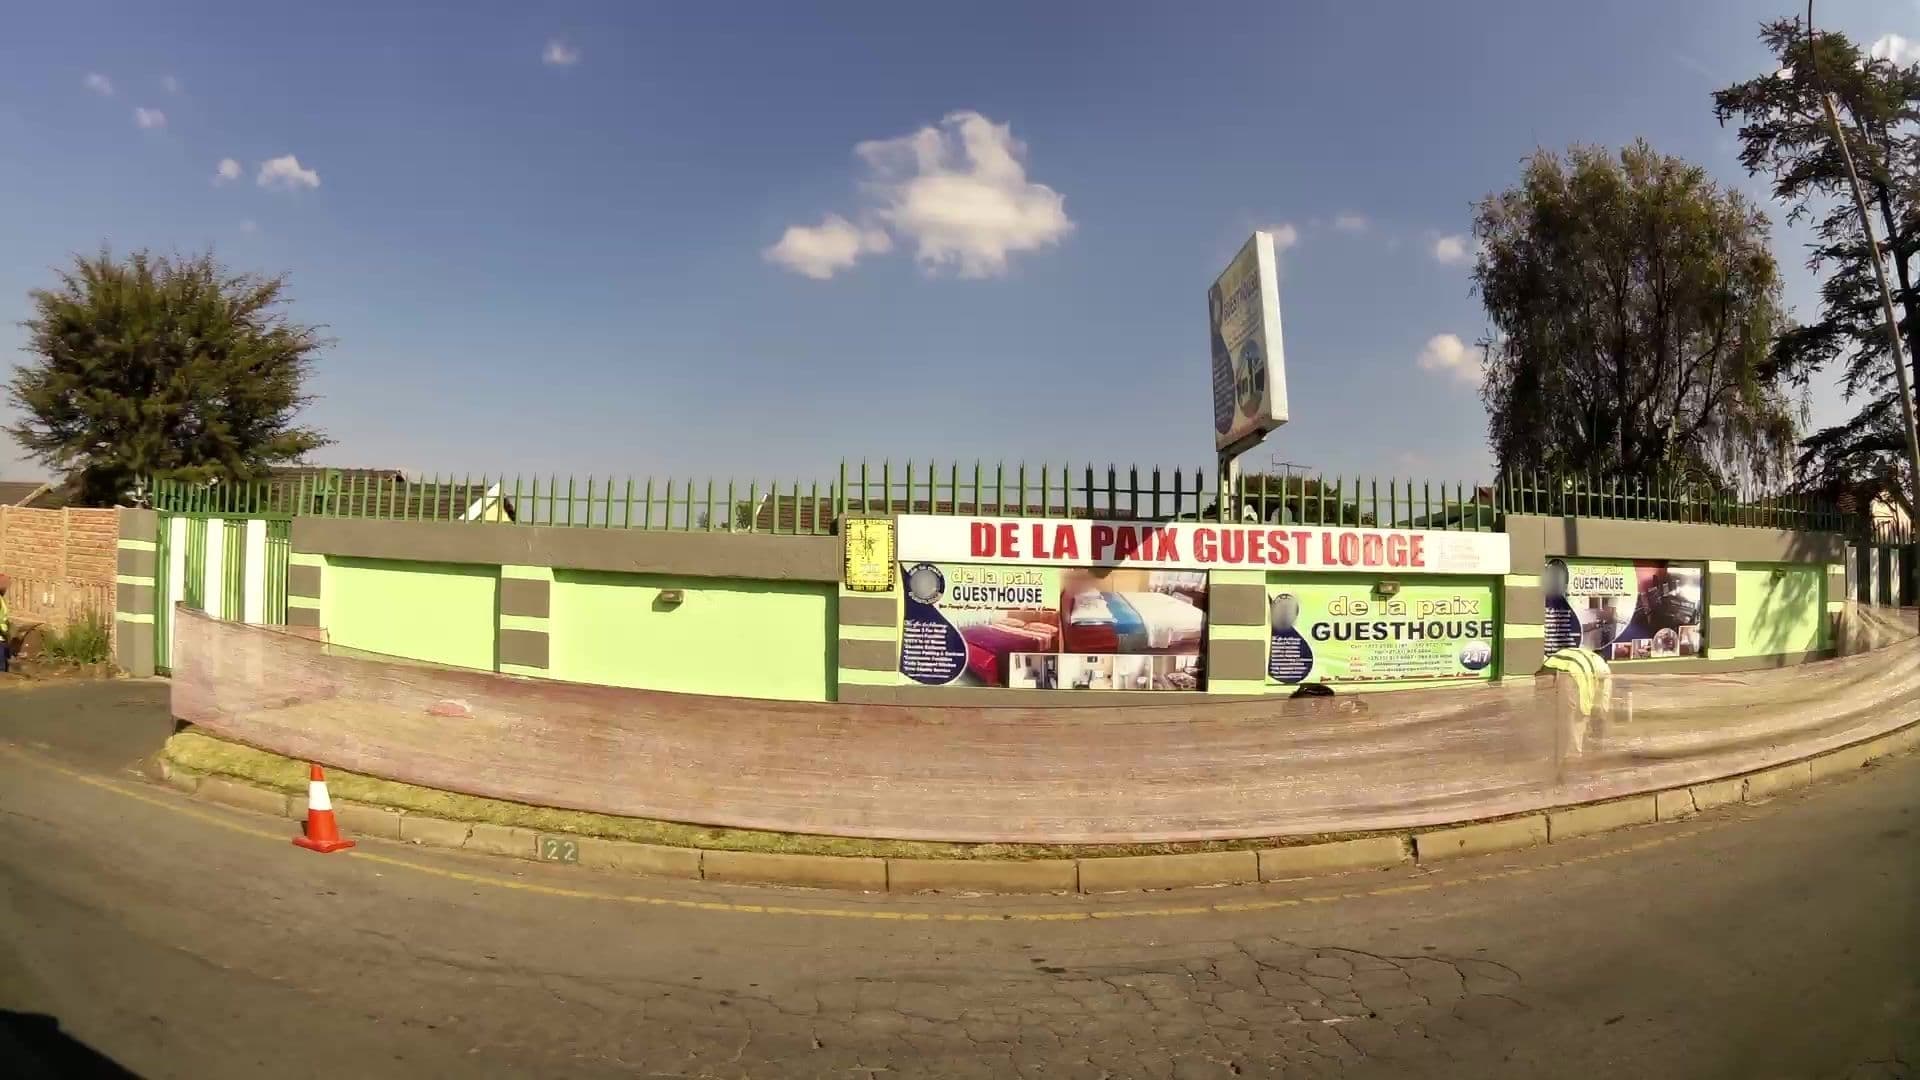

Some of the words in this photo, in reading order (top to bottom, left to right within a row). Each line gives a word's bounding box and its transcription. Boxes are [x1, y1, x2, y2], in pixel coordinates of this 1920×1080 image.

[971, 522, 1020, 558] DE
[1032, 524, 1079, 560] LA
[1090, 525, 1180, 563] PAIX
[1193, 528, 1312, 565] GUEST
[1323, 532, 1425, 568] LODGE
[951, 567, 973, 584] de
[980, 568, 997, 584] la
[1003, 569, 1044, 588] paix
[1573, 577, 1624, 590] GUESTHOUSE
[953, 586, 1043, 603] GUESTHOUSE
[1328, 596, 1368, 616] de
[1378, 596, 1407, 616] la
[1416, 596, 1479, 619] paix
[1311, 620, 1494, 641] GUESTHOUSE
[1462, 649, 1489, 664] 24/7
[547, 840, 577, 861] 22
